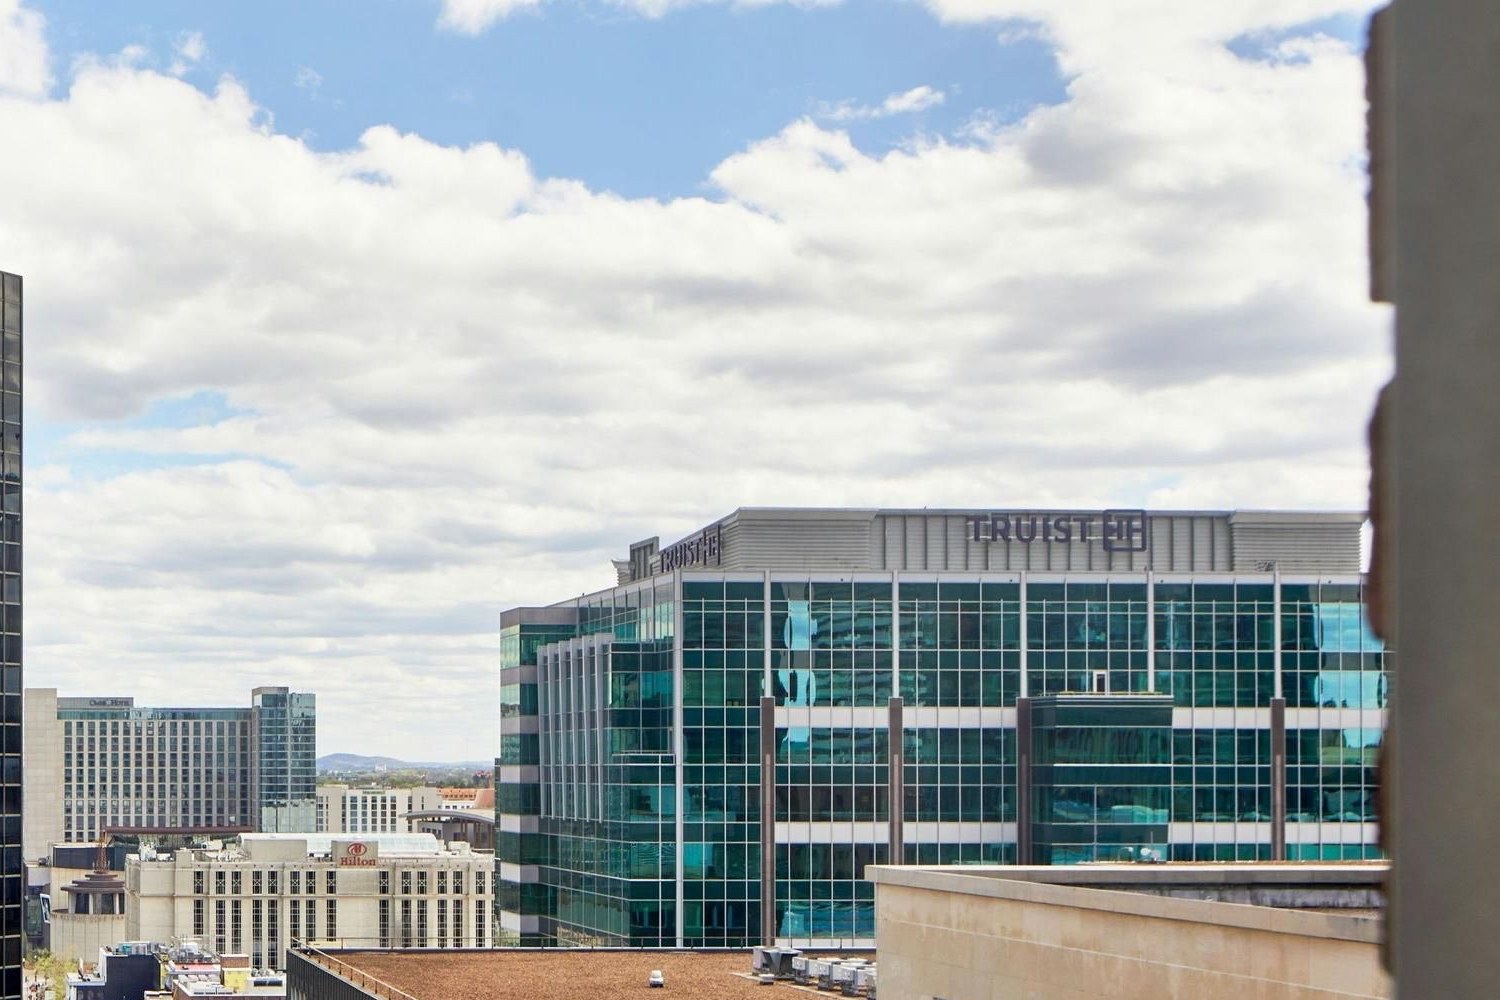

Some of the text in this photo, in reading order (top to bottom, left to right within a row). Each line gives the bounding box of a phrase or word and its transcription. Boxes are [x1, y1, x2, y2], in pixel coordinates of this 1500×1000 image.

[966, 514, 1094, 543] TRUIST
[660, 537, 703, 573] TRUIST
[340, 857, 376, 866] Hilton
